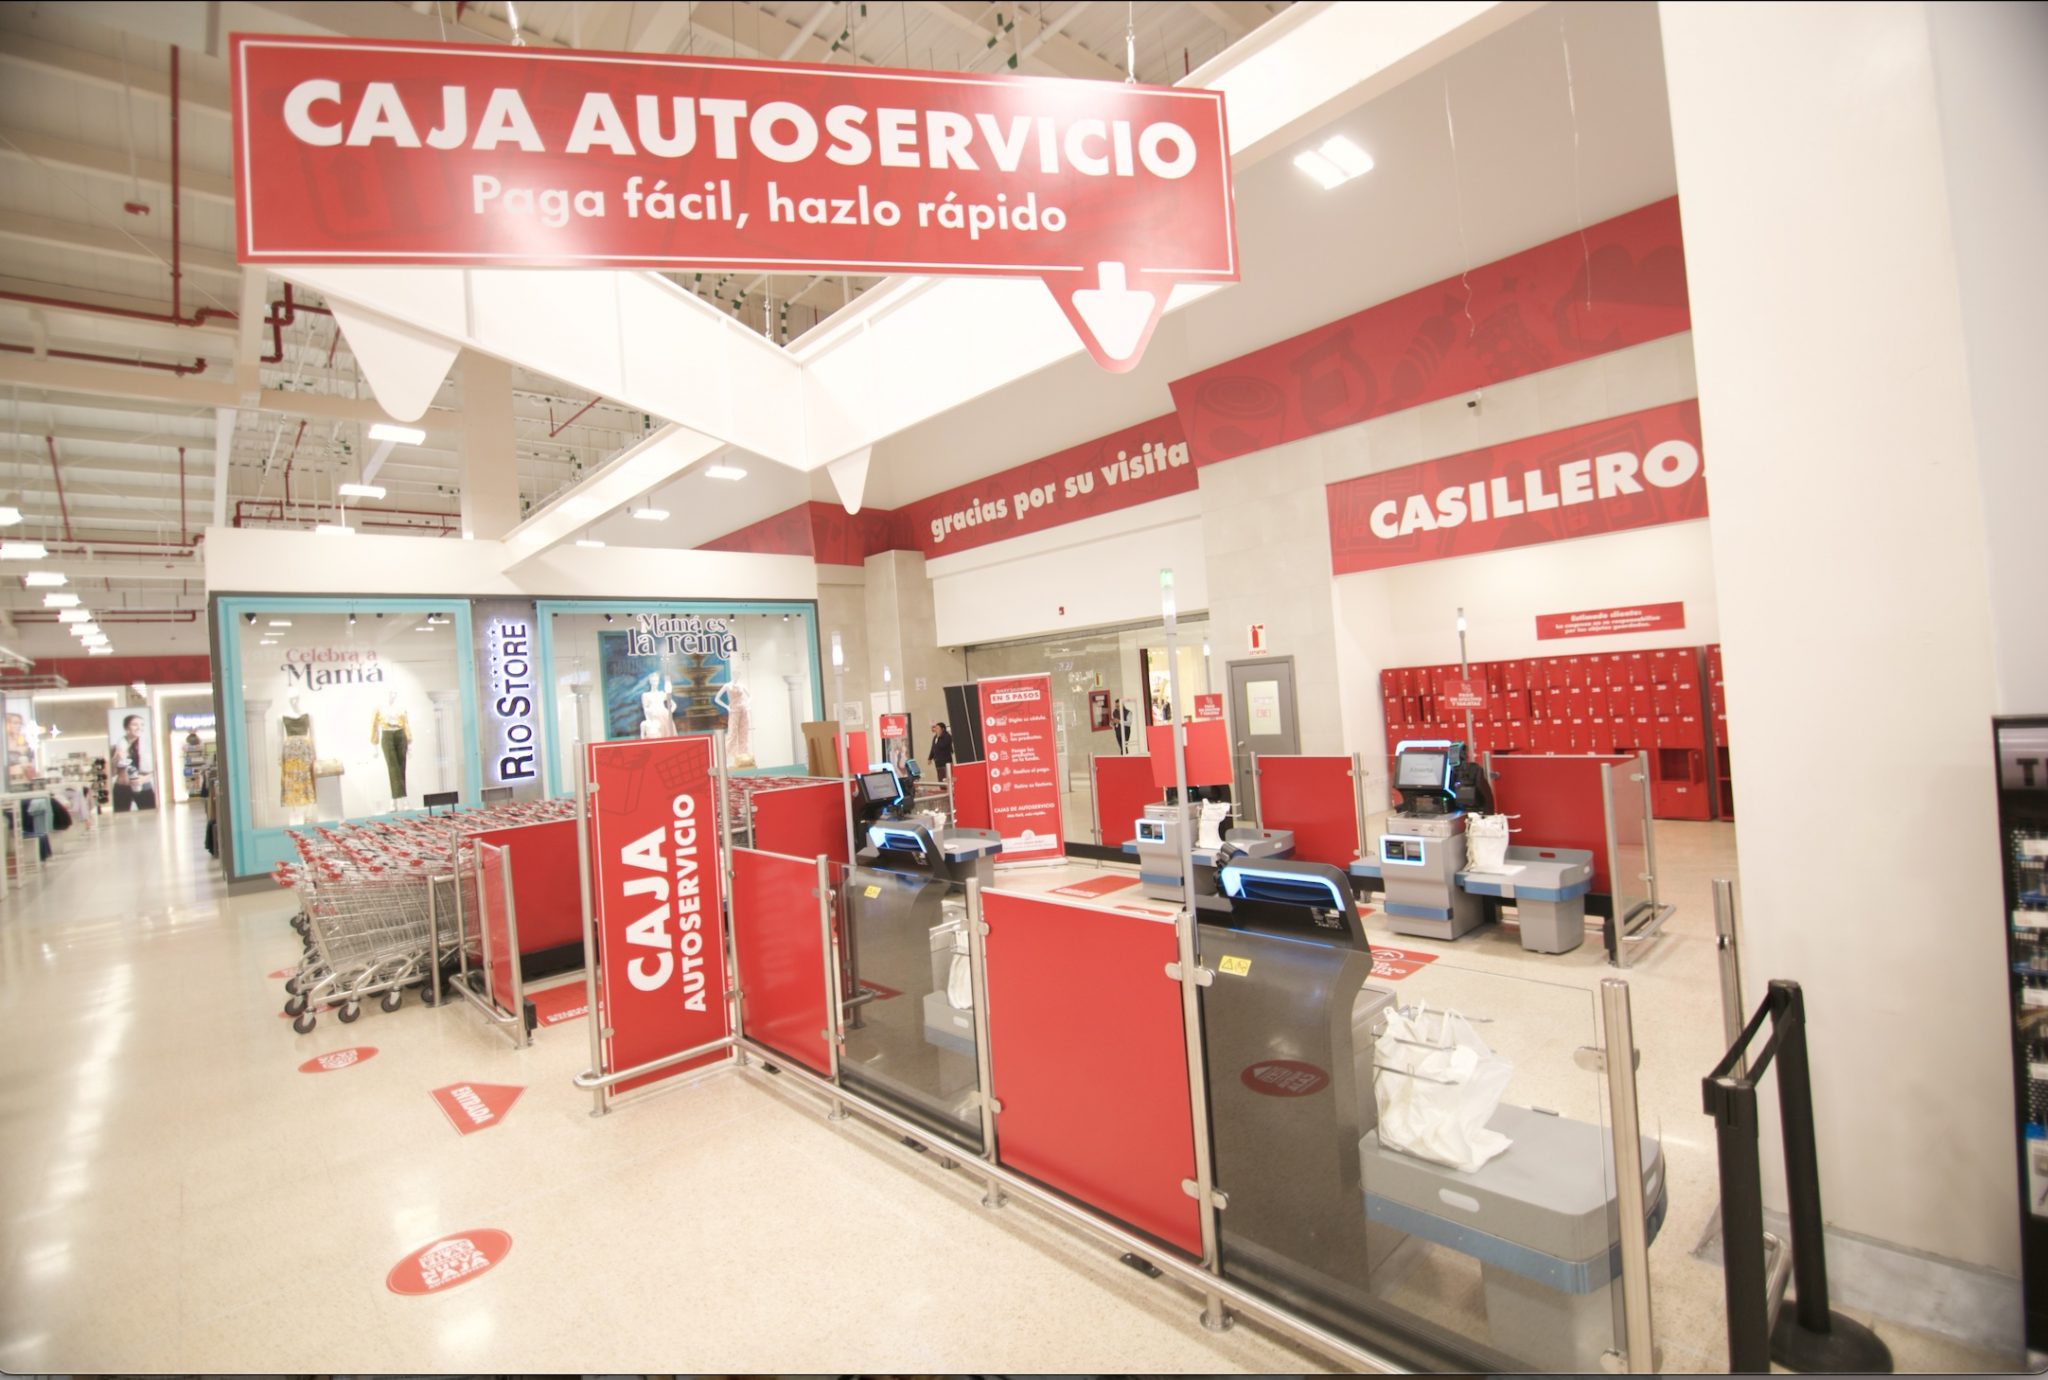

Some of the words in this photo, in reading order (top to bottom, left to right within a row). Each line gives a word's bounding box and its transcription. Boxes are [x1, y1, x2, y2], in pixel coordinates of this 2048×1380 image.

[283, 79, 545, 152] CAJA
[565, 91, 1197, 180] AUTOSERVICIO
[472, 174, 606, 229] Paga
[623, 176, 749, 231] fácil,
[767, 180, 902, 228] hazlo
[917, 190, 1068, 240] rápido
[930, 497, 1008, 543] gracias
[1013, 482, 1057, 520] por
[1064, 471, 1095, 498] su
[1101, 441, 1190, 486] visita
[1369, 438, 1708, 540] CASILLERO
[637, 613, 700, 634] Mamá
[704, 618, 726, 632] es
[285, 648, 358, 664] Celebra
[365, 651, 377, 662] a
[627, 628, 655, 656] la
[667, 631, 738, 659] reina
[280, 662, 384, 691] Mamá
[1012, 692, 1039, 700] PASOS
[1018, 802, 1056, 811] AUTOSERVICIO
[620, 825, 674, 992] CAJA
[672, 794, 707, 1013] AUTOSERVICIO
[450, 1086, 495, 1125] ENTRADA
[424, 1256, 491, 1287] CAJA
